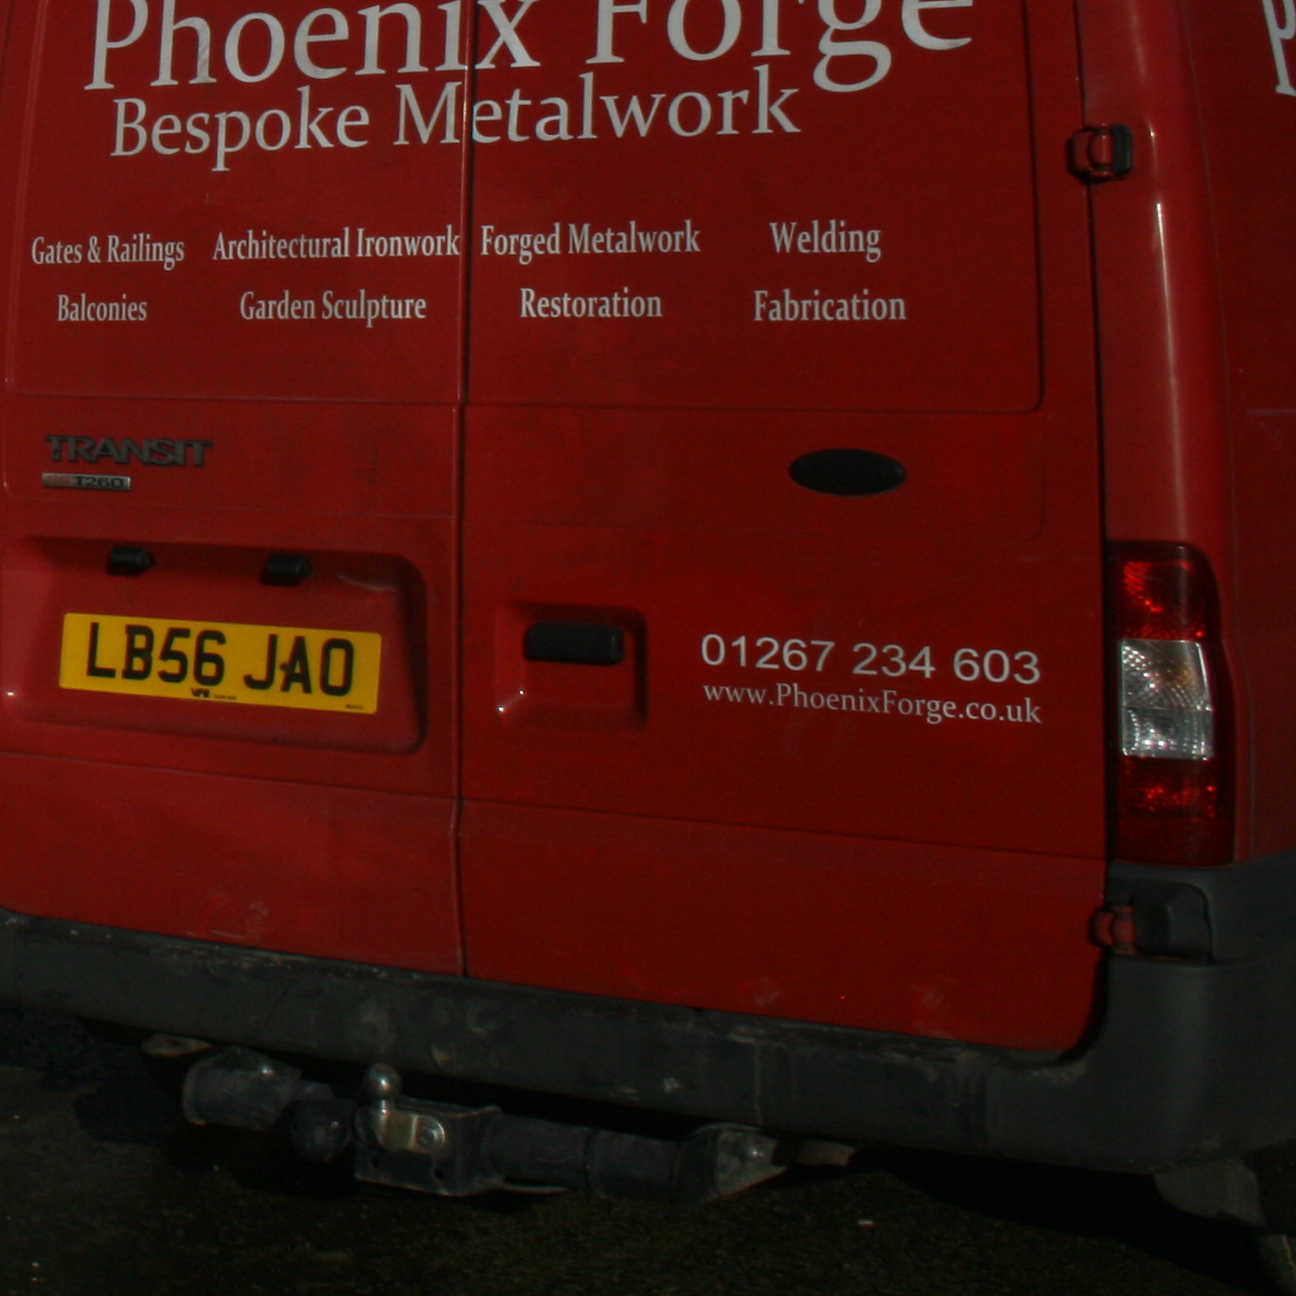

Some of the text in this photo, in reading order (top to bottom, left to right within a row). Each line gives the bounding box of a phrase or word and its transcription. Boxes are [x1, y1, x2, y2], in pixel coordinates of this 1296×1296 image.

[109, 64, 802, 172] Bespoke Metalwork
[31, 232, 186, 271] Gates & Railings
[211, 223, 461, 261] Architectural Ironwork
[480, 219, 701, 265] Forged Metalwork
[769, 218, 882, 263] Welding
[57, 292, 148, 322] Balconies
[239, 288, 427, 328] Garden Sculpture
[519, 286, 663, 318] Restoration
[753, 288, 907, 322] Fabrication
[45, 435, 214, 467] TRANSIT
[75, 475, 124, 489] T260
[85, 621, 355, 697] LB56 JAO
[700, 633, 1042, 685] 01267 234 603
[702, 680, 1042, 725] www.PhoenixForge.co.uk
